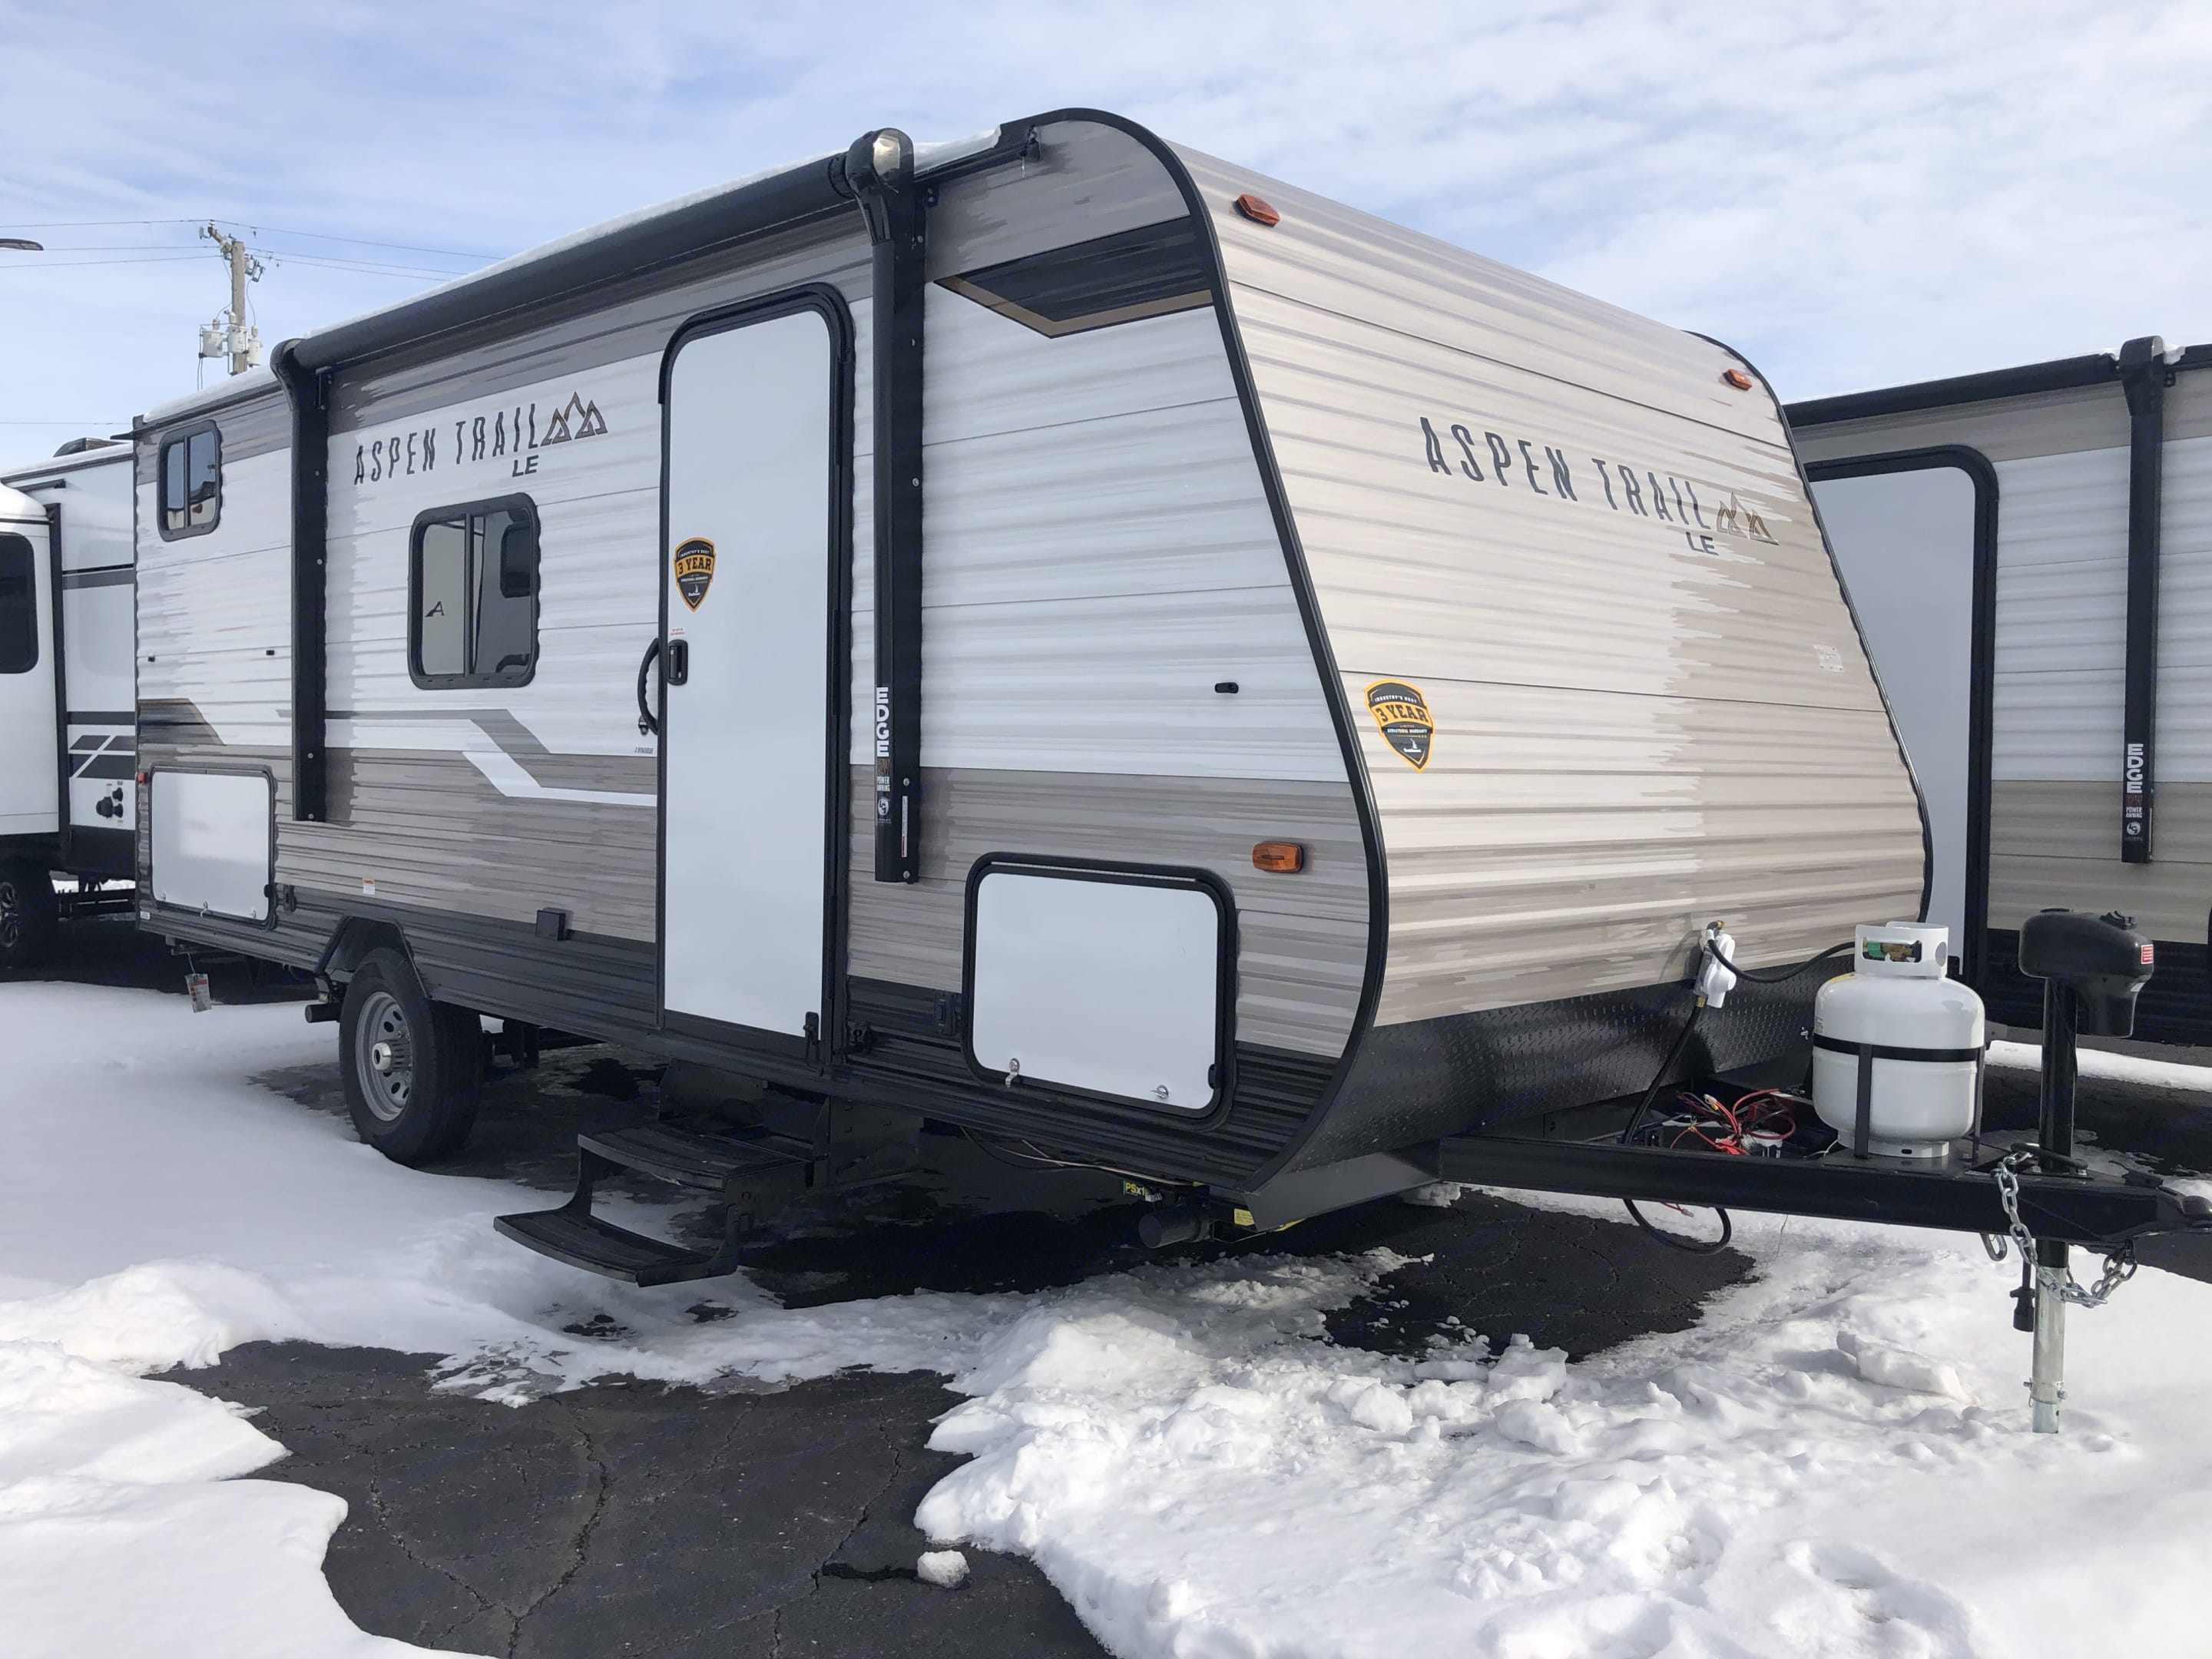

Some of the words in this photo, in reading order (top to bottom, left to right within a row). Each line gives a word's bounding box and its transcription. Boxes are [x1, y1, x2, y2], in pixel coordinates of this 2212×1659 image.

[354, 428, 435, 485] ASPEN
[455, 403, 538, 465] TRAIL
[512, 455, 539, 477] LE
[1419, 416, 1578, 502] ASPEN
[1591, 457, 1712, 530] TRAIL
[1685, 531, 1719, 555] LE
[677, 562, 684, 575] 3
[685, 557, 712, 571] YEAR
[1374, 694, 1403, 703] INDUSTRY'S
[876, 687, 890, 757] EDGE
[1375, 707, 1389, 722] 3
[1385, 704, 1429, 723] YEAR
[2126, 743, 2144, 793] EDGE
